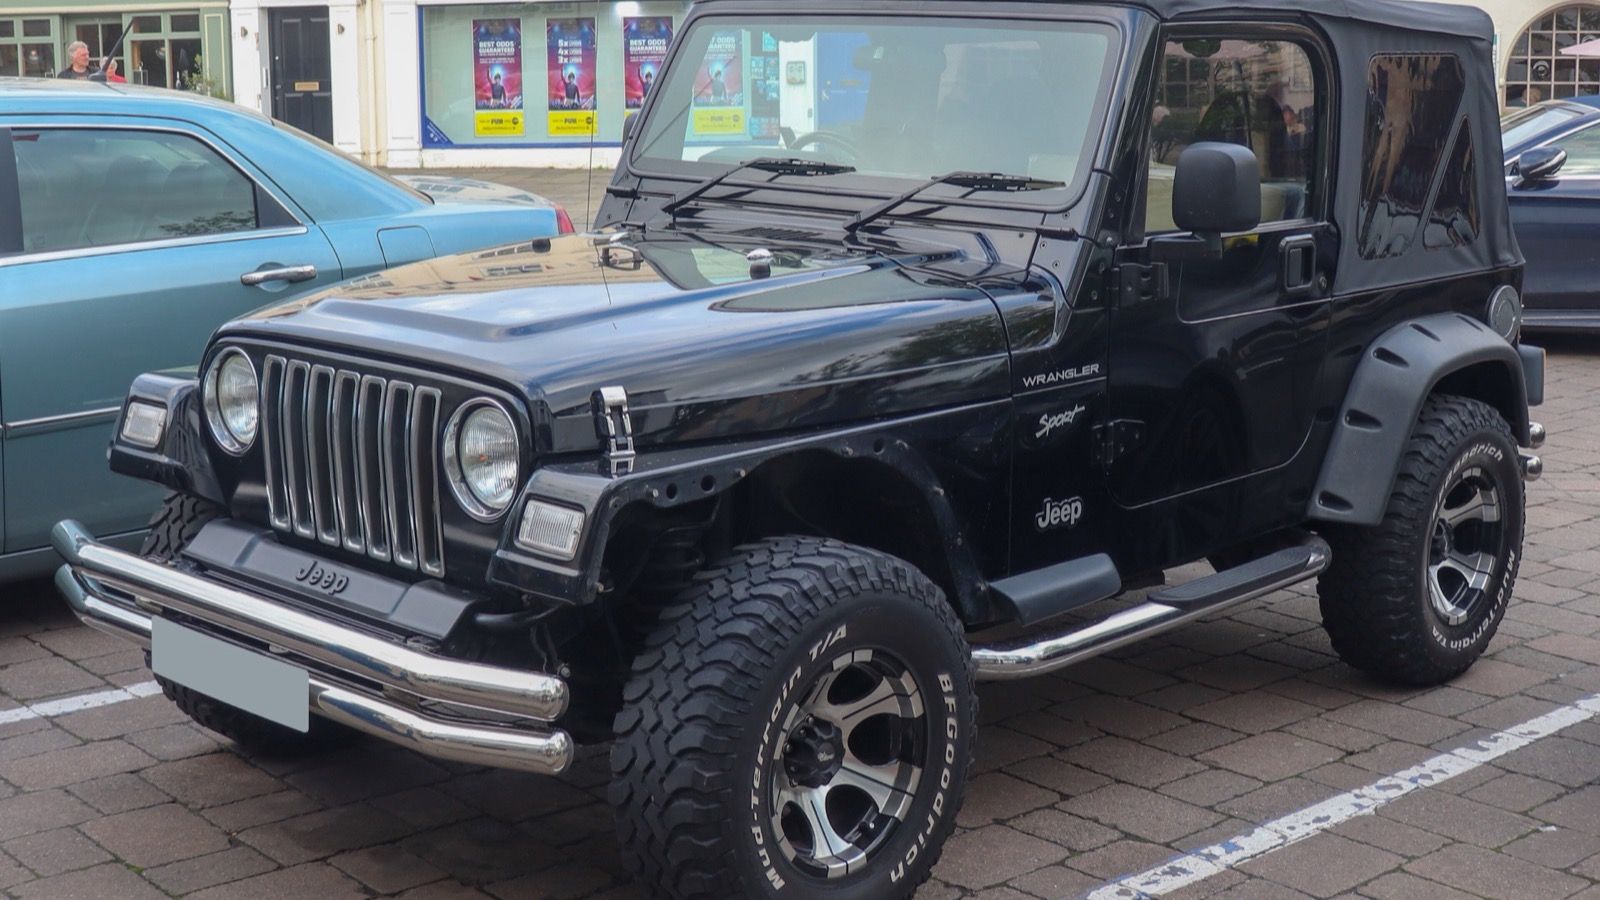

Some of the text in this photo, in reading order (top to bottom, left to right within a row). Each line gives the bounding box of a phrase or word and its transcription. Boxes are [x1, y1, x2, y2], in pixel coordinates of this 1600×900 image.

[479, 40, 514, 48] BEST ODDS
[647, 38, 666, 46] ODDS
[1022, 363, 1100, 388] WRANGLER
[1035, 403, 1086, 439] Sport
[1036, 496, 1083, 530] Jeep
[296, 560, 350, 596] Jeep
[807, 623, 848, 662] T/A
[889, 671, 959, 885] BFGoodrich
